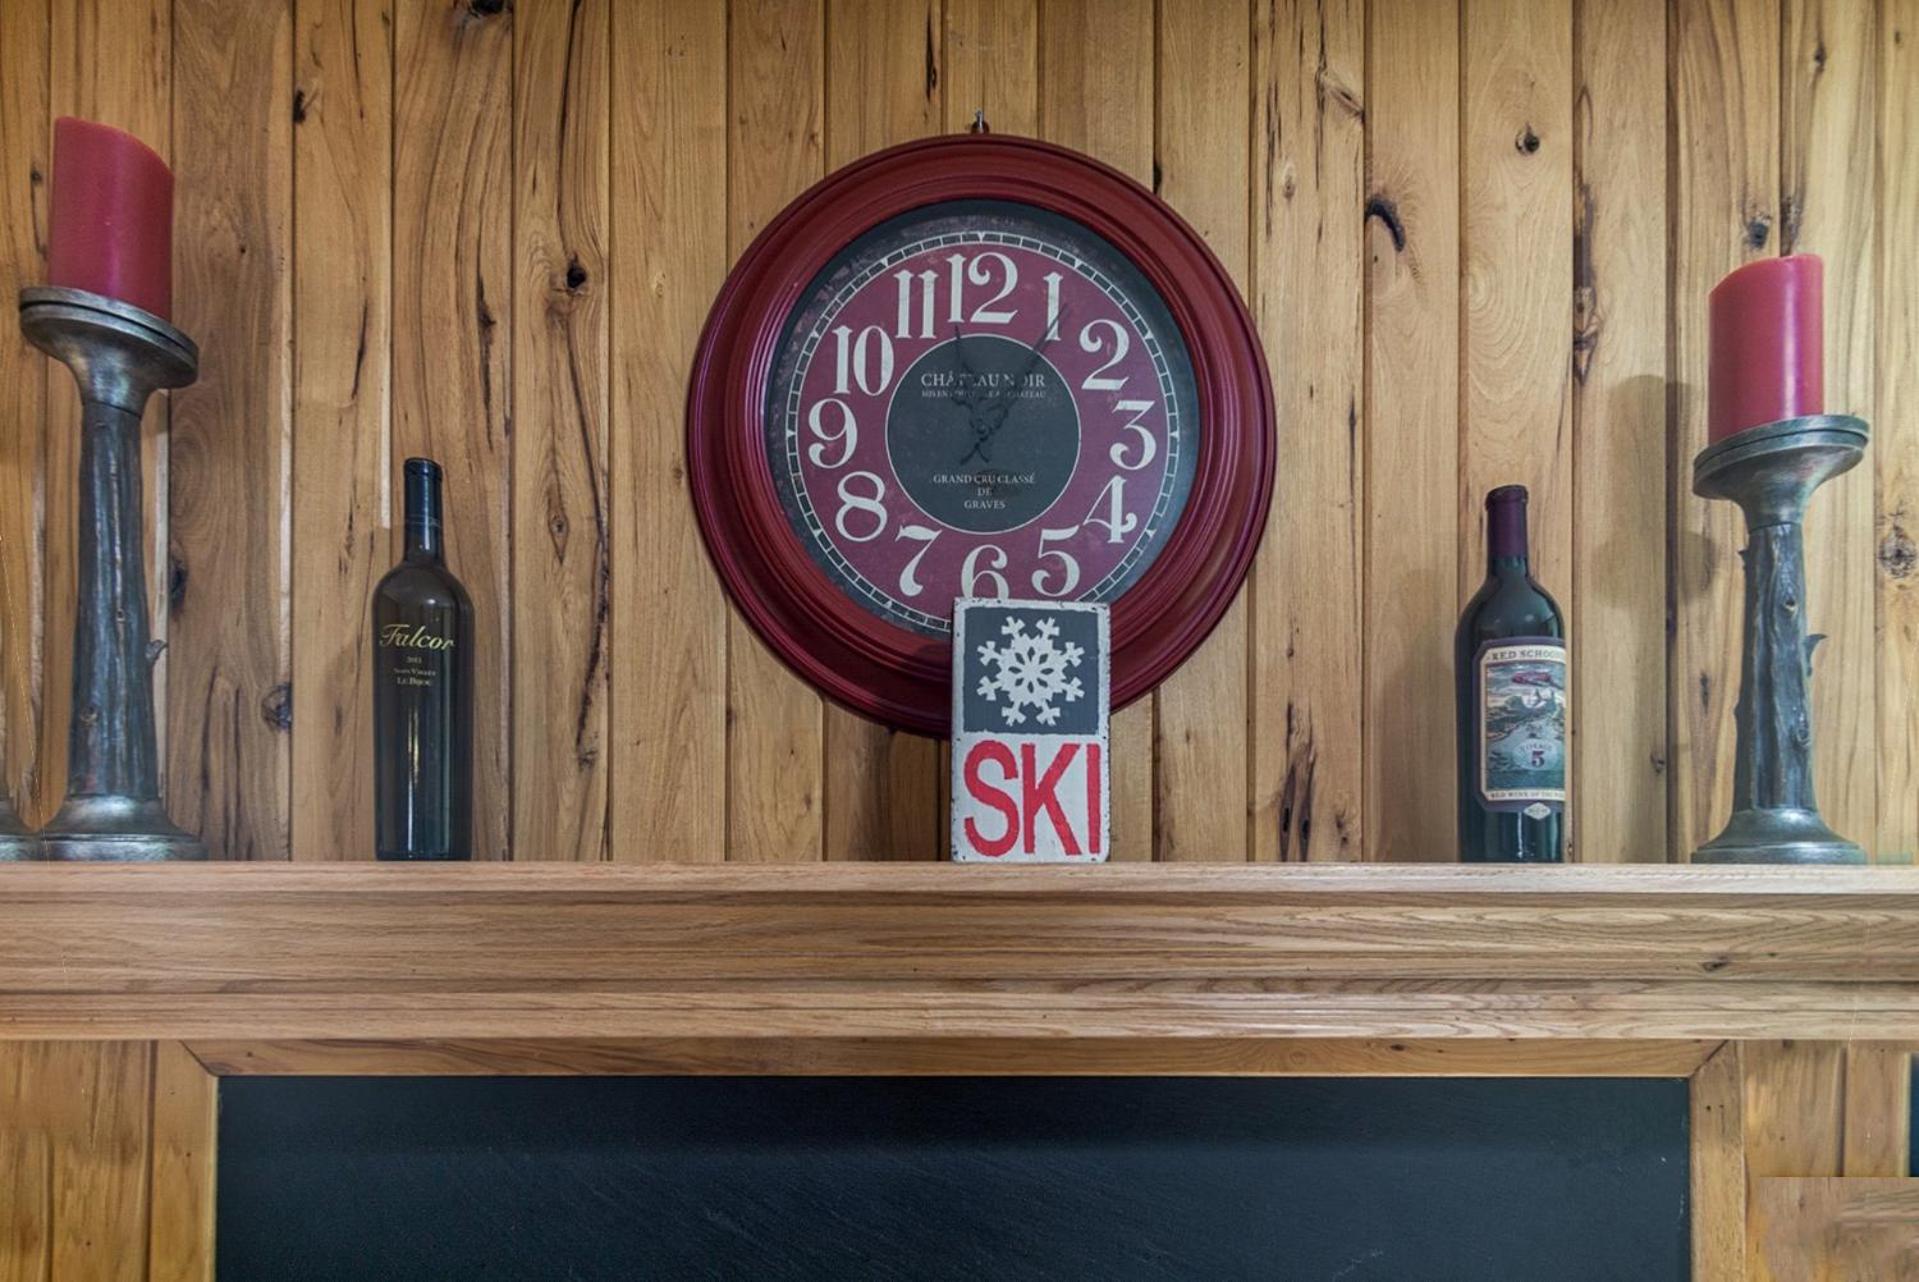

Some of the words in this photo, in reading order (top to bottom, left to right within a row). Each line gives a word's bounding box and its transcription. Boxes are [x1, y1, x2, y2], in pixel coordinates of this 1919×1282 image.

[893, 269, 939, 339] 11
[947, 252, 1019, 325] 12
[1043, 272, 1062, 341] 1
[832, 325, 895, 396] 10
[1079, 319, 1130, 391] 2
[808, 398, 858, 469] 9
[1109, 400, 1157, 470] 3
[835, 471, 888, 542] 8
[933, 474, 972, 484] GRAND
[973, 474, 996, 484] CRU
[963, 500, 1006, 509] GRAVES
[977, 487, 992, 497] DE
[1082, 475, 1138, 544] 4
[894, 524, 943, 597] 7
[960, 544, 1009, 599] 6
[1031, 525, 1080, 597] 5
[380, 624, 454, 650] Falcor
[1491, 650, 1517, 661] RED
[1531, 750, 1545, 767] 5
[963, 740, 1101, 857] SKI
